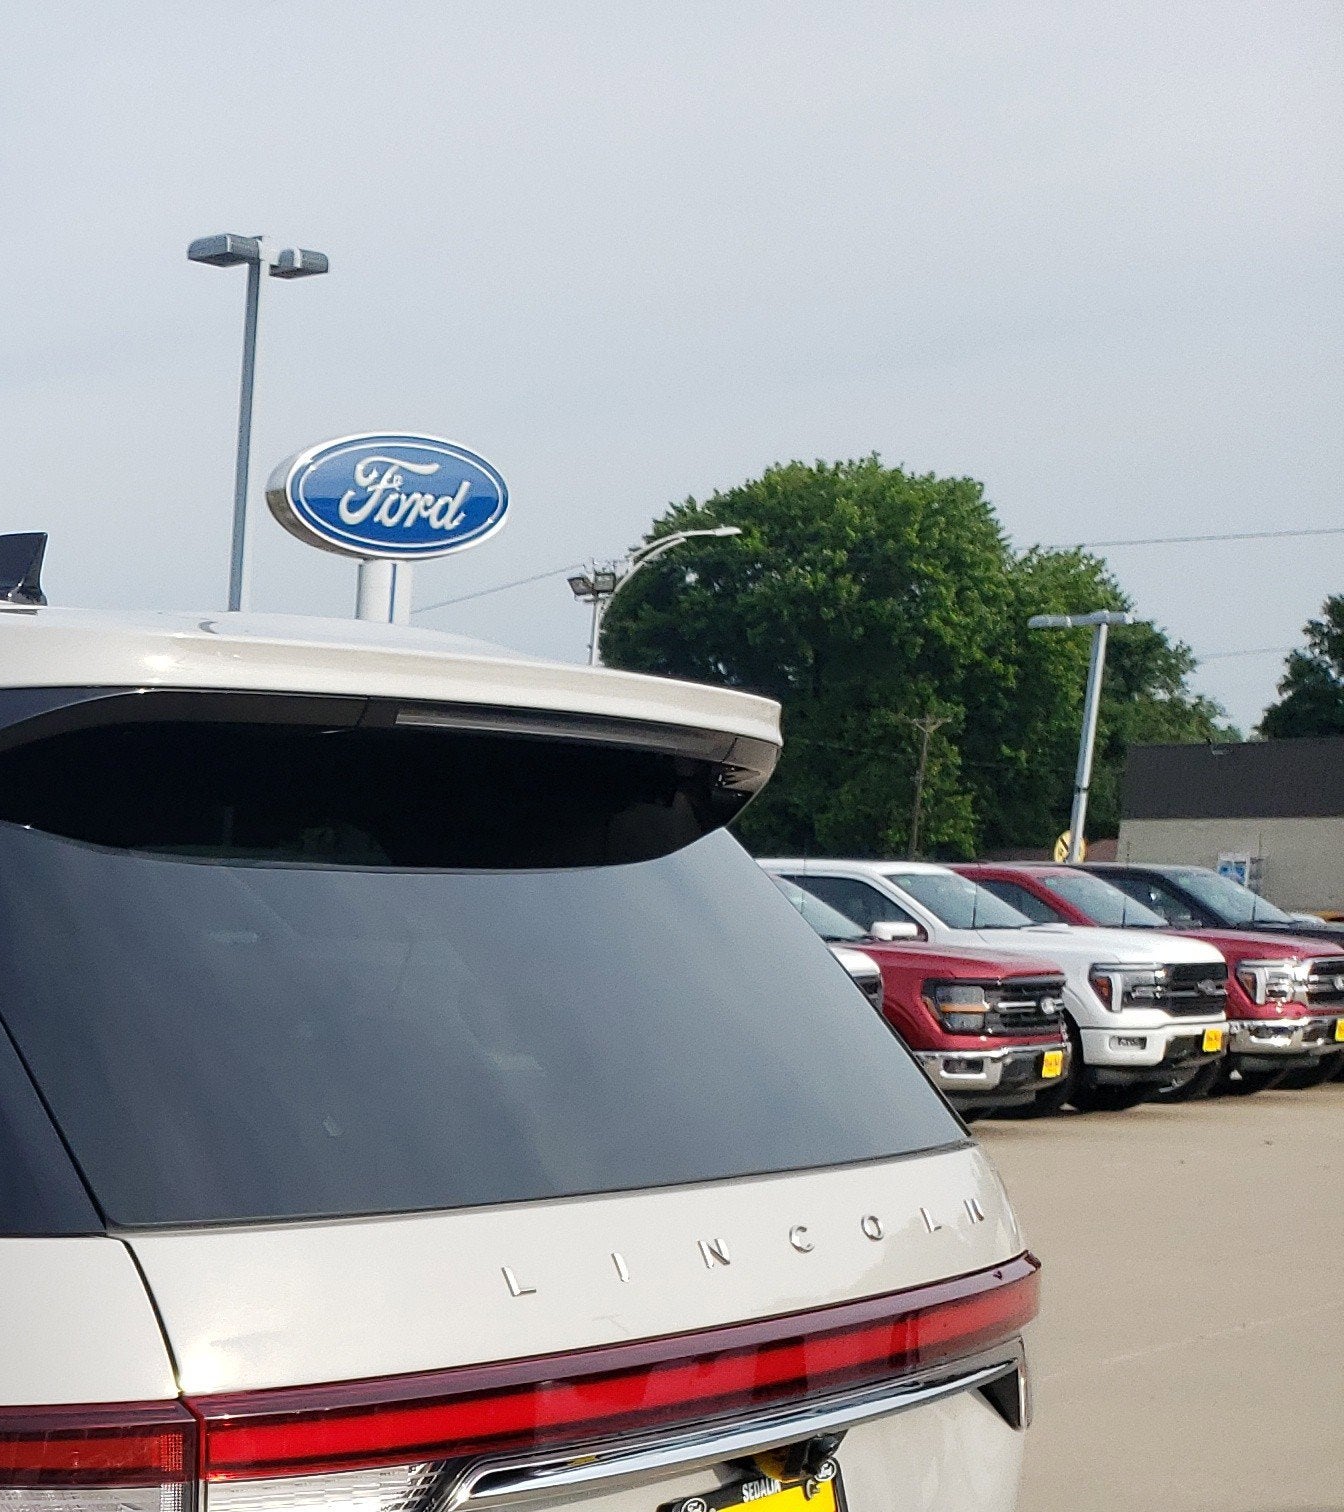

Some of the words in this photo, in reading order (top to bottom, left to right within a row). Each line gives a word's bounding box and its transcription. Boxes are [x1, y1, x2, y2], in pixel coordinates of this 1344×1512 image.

[338, 455, 472, 531] Ford
[500, 1197, 985, 1298] LINCOLN
[742, 1477, 782, 1503] SEDALIA
